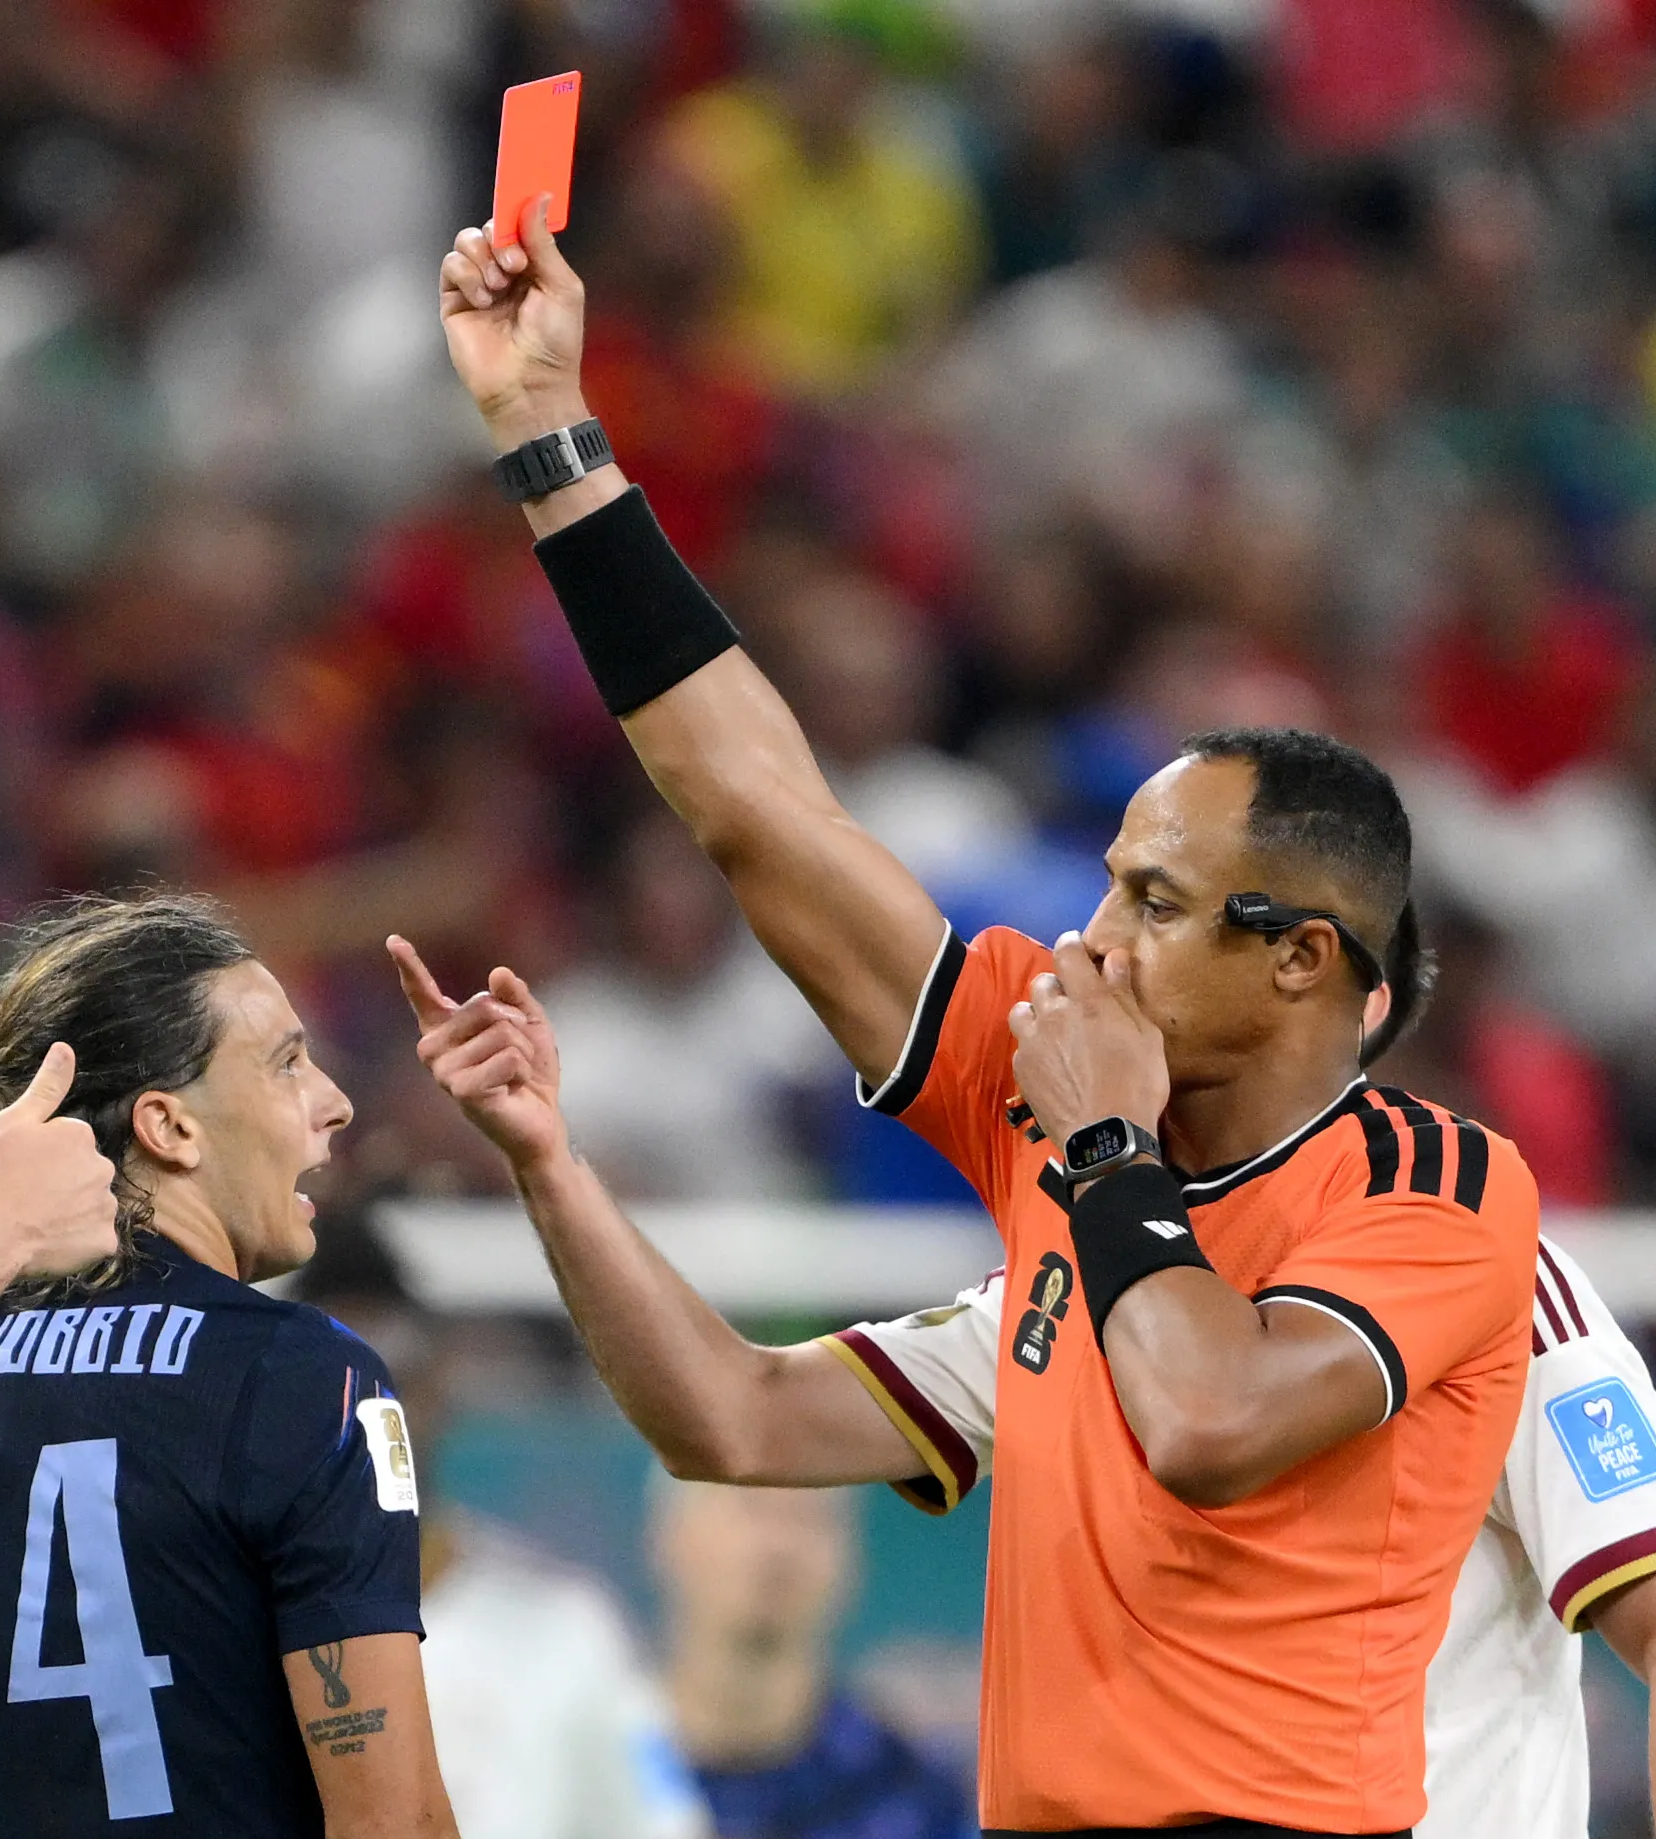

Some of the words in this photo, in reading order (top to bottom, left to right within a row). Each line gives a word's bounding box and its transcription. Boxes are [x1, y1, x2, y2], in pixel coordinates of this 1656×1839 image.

[1021, 1342, 1042, 1365] FIFA
[1598, 1441, 1643, 1473] PEACE
[1615, 1464, 1641, 1481] FIFA
